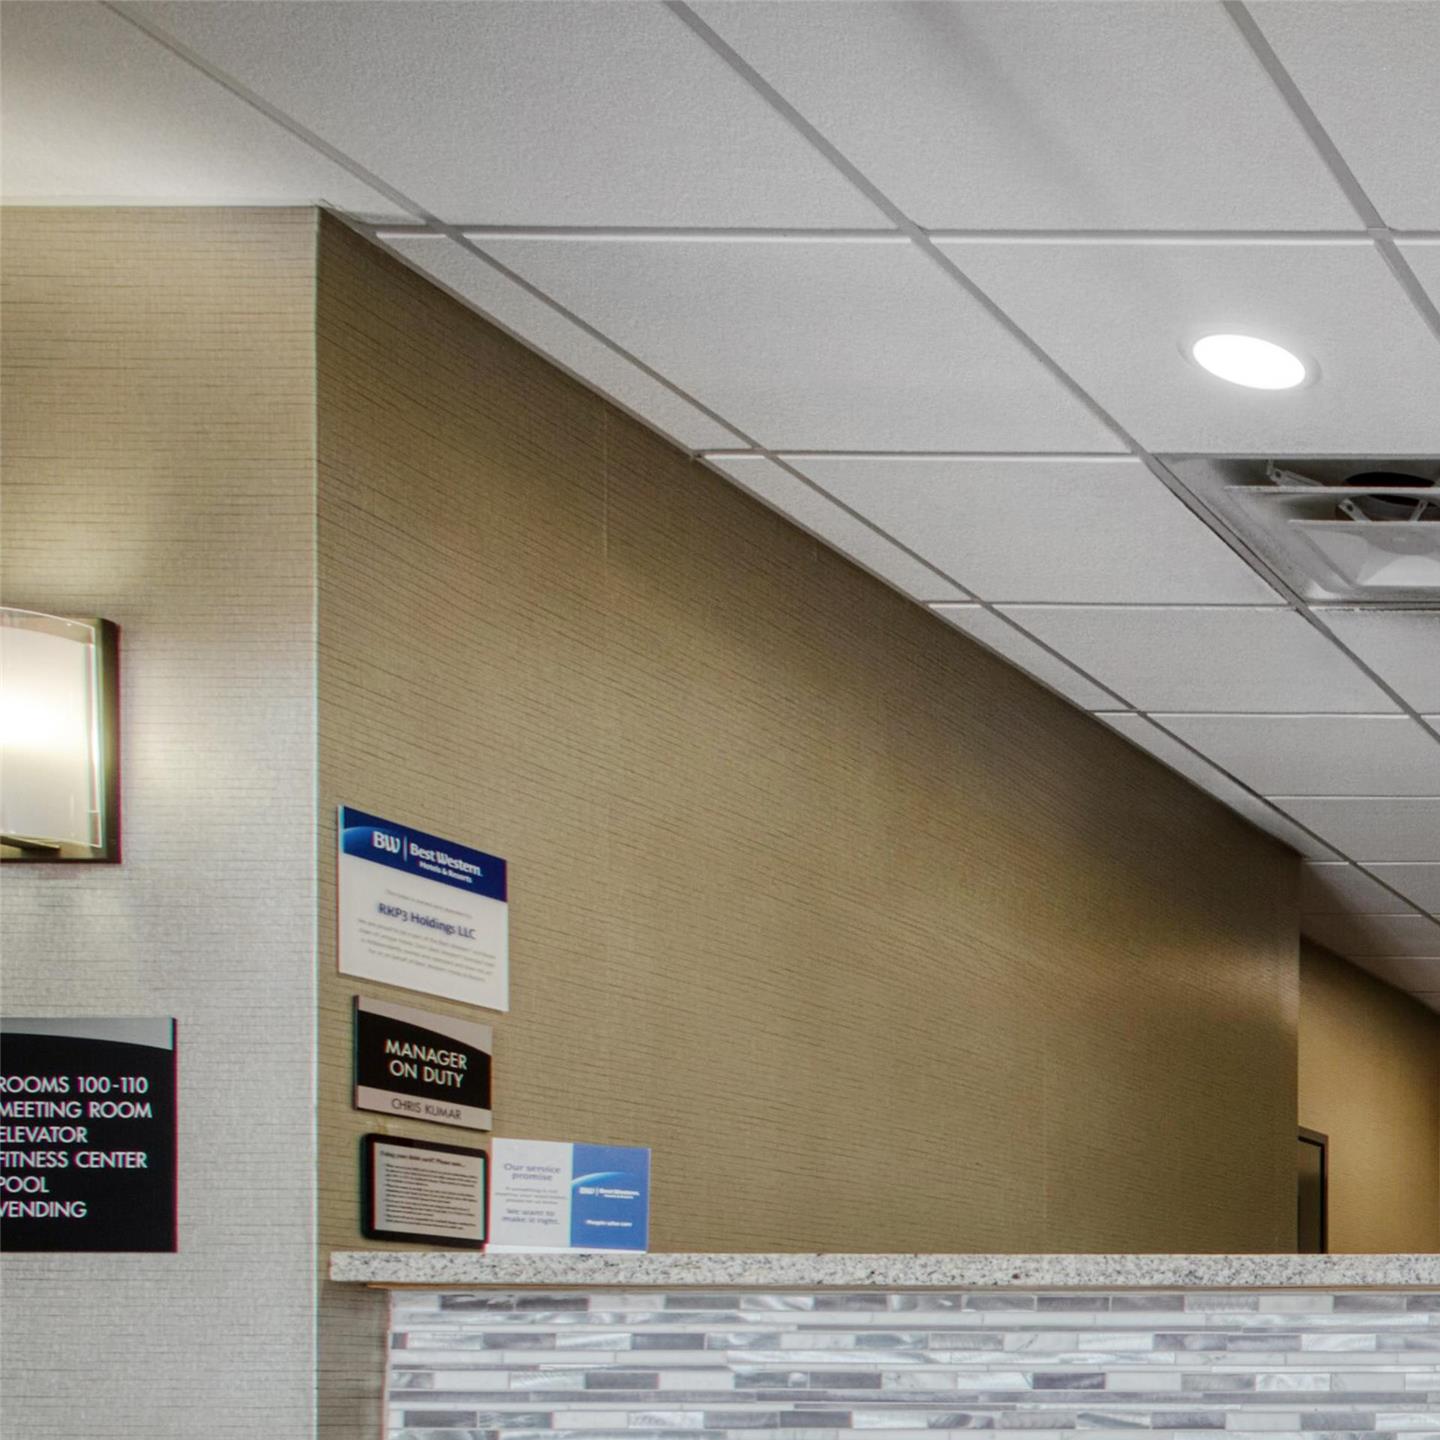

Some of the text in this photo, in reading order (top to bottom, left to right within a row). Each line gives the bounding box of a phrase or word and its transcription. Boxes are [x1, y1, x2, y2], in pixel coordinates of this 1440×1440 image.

[373, 831, 482, 877] BW Best Western
[378, 903, 408, 922] RKP3
[410, 912, 456, 935] Holdings
[458, 926, 477, 940] LLC
[386, 1039, 467, 1070] MANAGER
[390, 1060, 464, 1088] ON DUTY
[0, 1076, 149, 1094] ROOMS 100-110
[0, 1101, 152, 1118] MEETING ROOM
[391, 1098, 461, 1119] CHRIS KUMAR
[0, 1126, 88, 1143] ELEVATOR
[0, 1151, 148, 1169] FITNESS CENTER
[0, 1176, 50, 1193] POOL
[0, 1201, 87, 1218] VENDING
